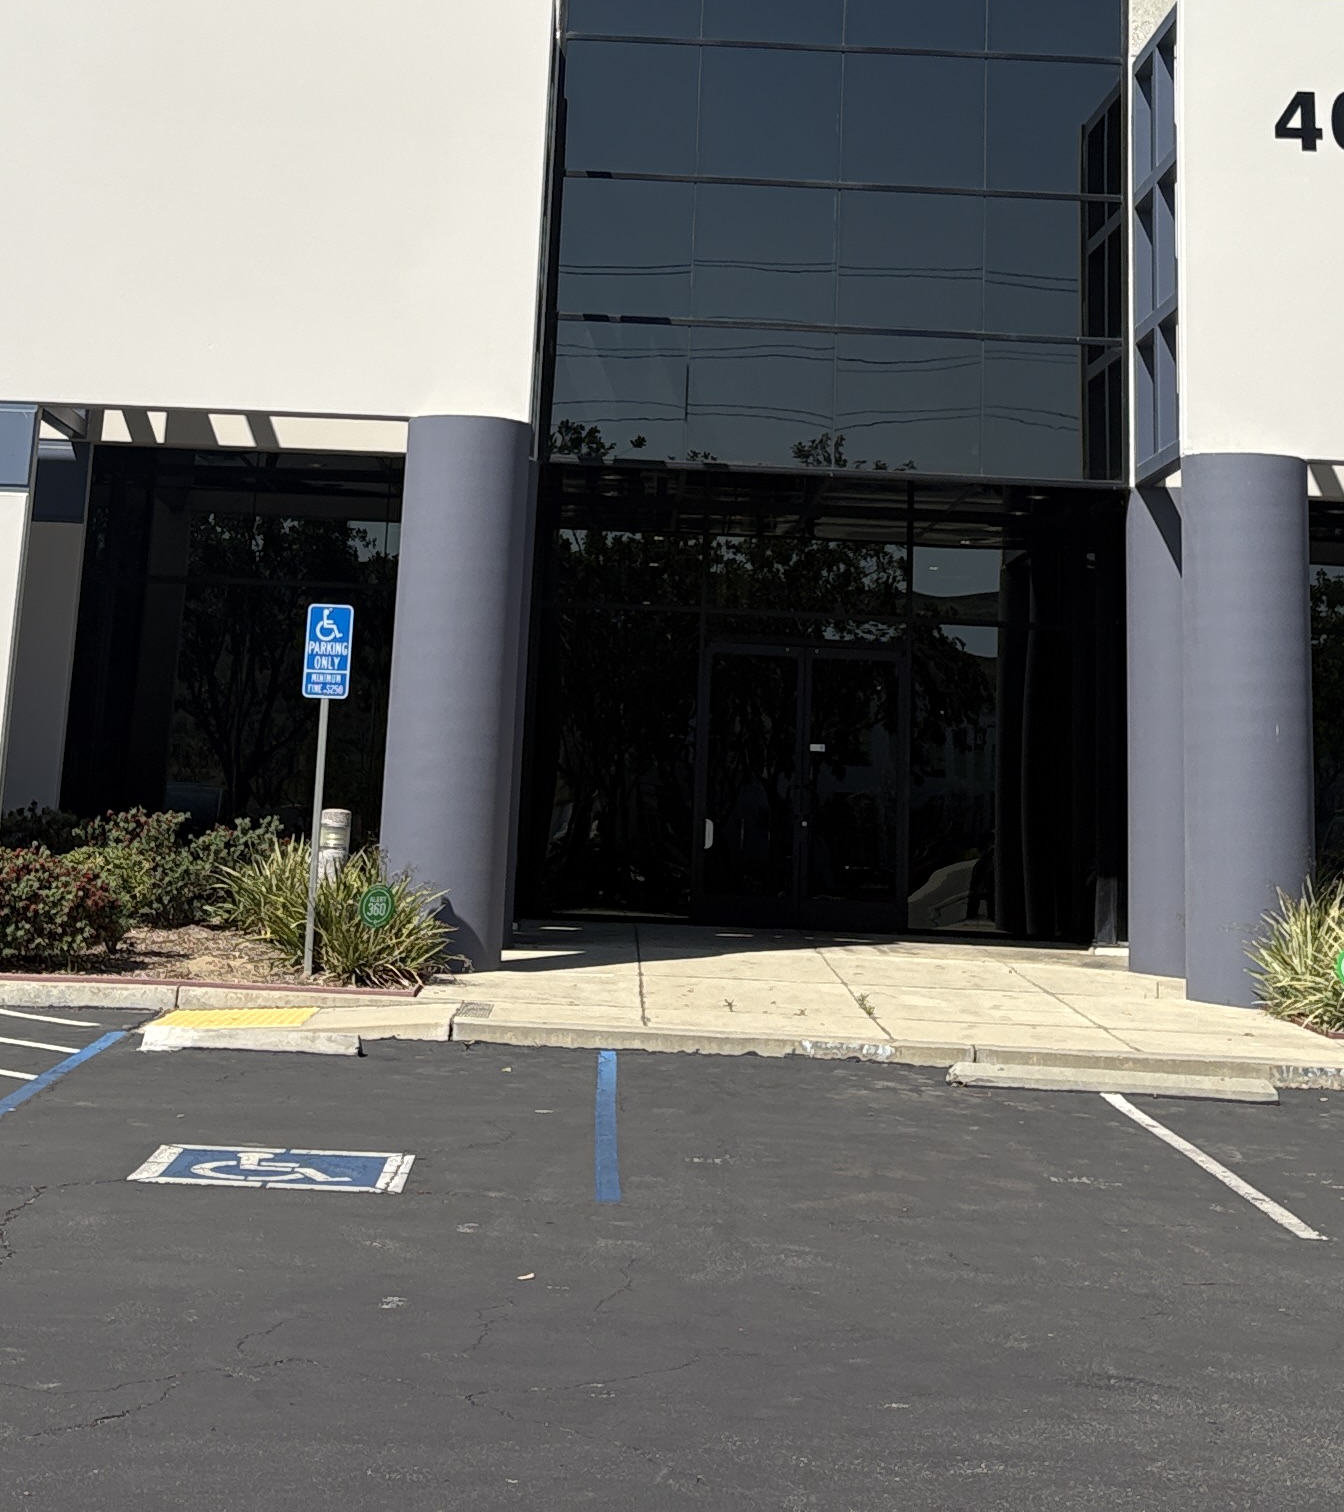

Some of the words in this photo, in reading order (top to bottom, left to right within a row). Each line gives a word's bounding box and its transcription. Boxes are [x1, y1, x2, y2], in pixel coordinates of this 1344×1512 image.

[308, 641, 348, 656] PARKING
[314, 656, 341, 670] ONLY
[367, 902, 387, 917] 360
